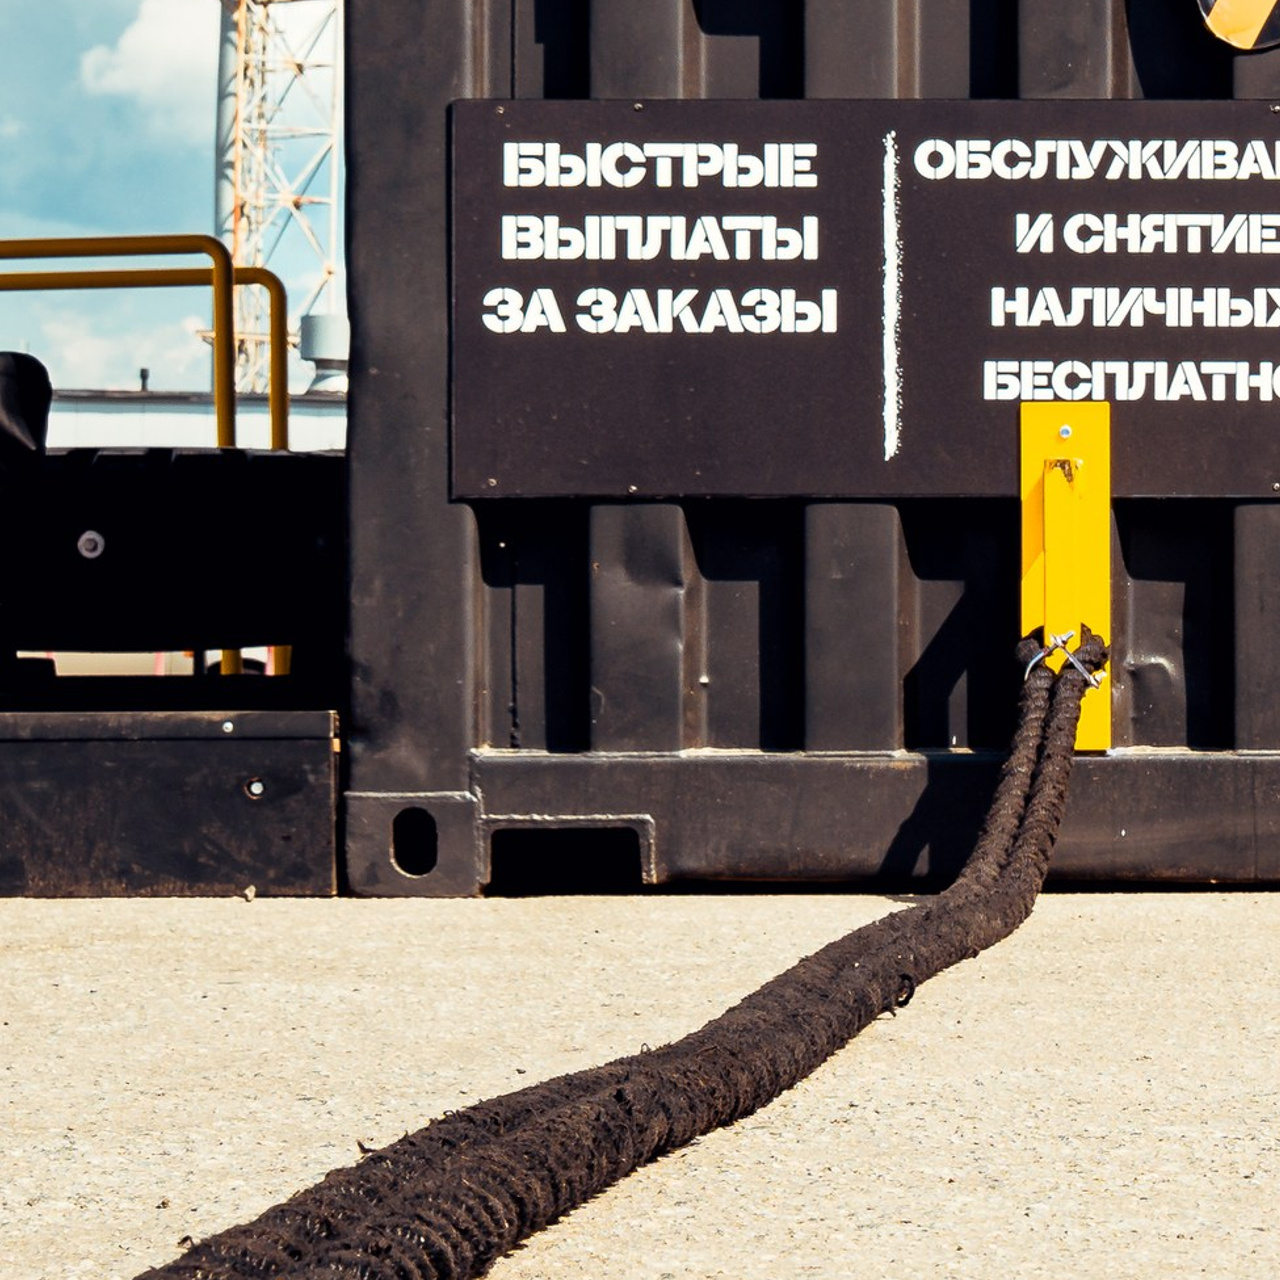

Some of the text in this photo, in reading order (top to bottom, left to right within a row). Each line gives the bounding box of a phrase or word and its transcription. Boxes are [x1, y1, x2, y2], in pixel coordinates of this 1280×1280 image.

[502, 142, 818, 188] БЫСТРЫЕ
[501, 215, 819, 261] ВЫПЛАТЫ
[1015, 213, 1054, 254] И
[481, 287, 838, 334] ЗА ЗАКАЗЫ
